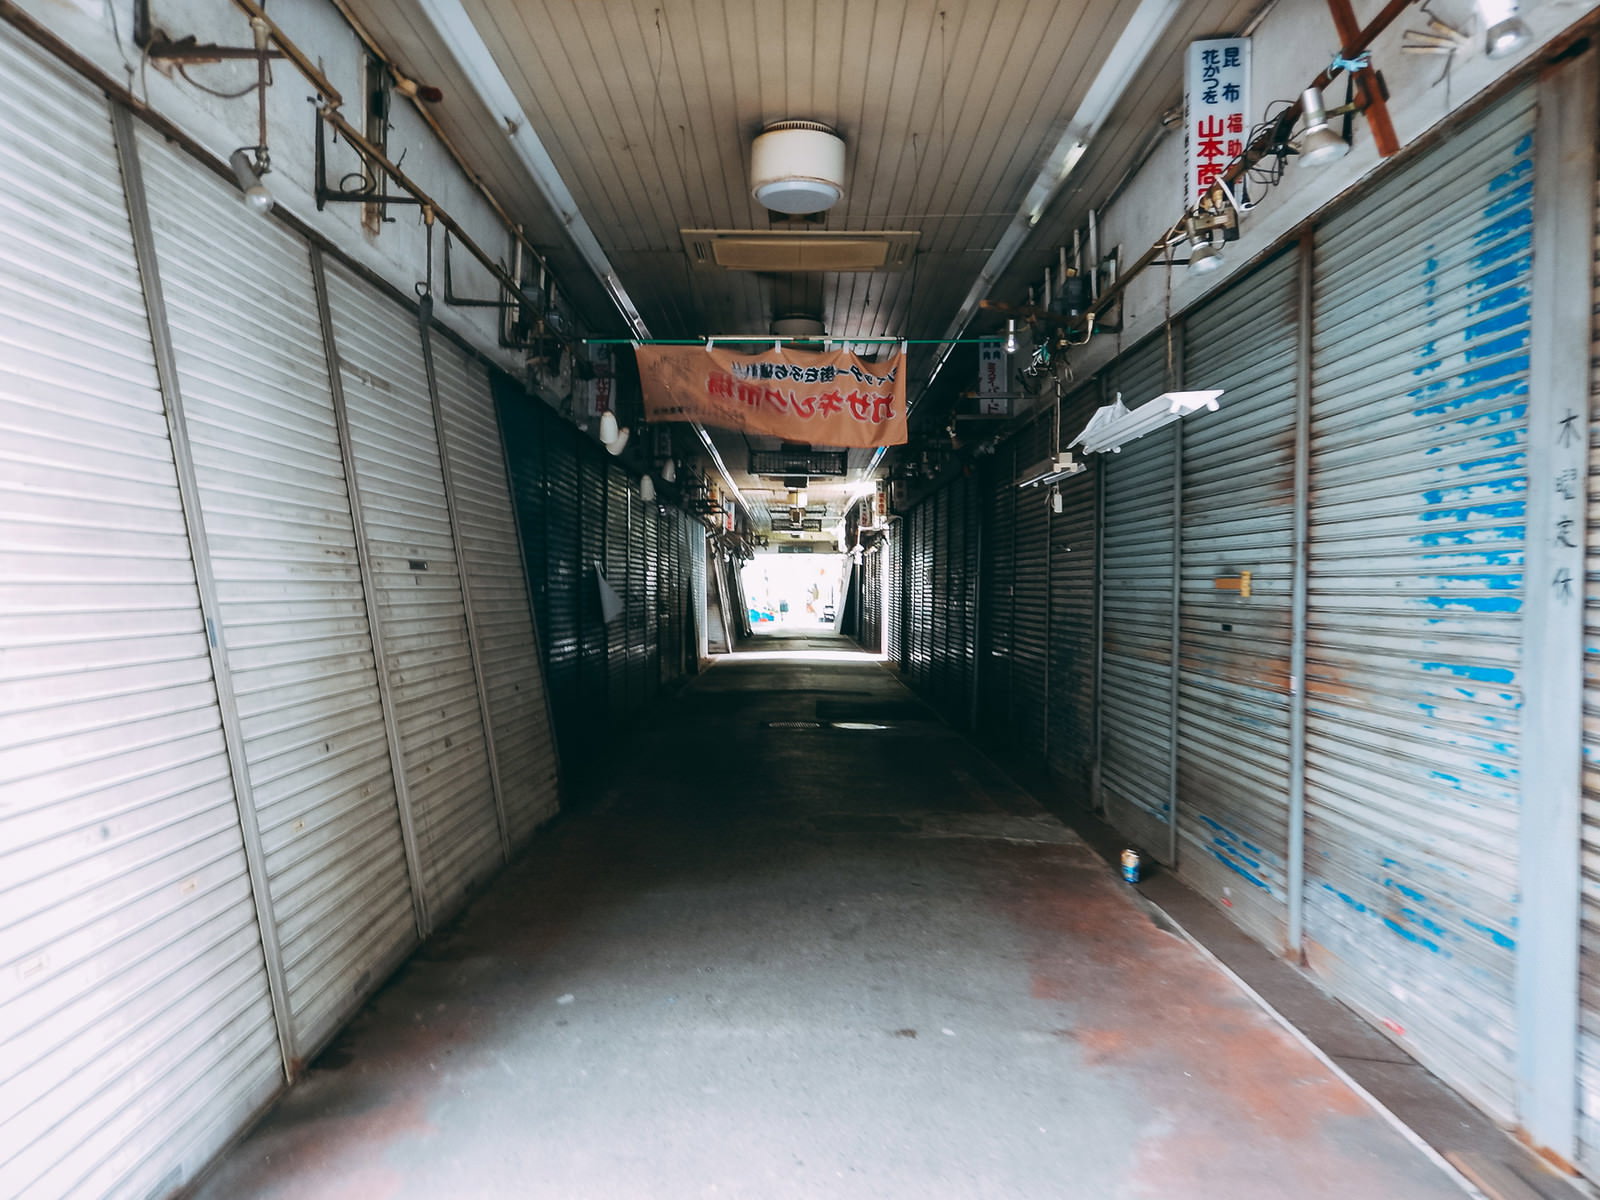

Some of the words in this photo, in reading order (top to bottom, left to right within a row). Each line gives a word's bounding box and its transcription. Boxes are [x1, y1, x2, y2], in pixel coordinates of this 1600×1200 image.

[1202, 49, 1220, 104] 花かつを
[1222, 47, 1241, 103] 昆布
[1197, 115, 1224, 197] 山本商
[1227, 113, 1243, 184] 福助
